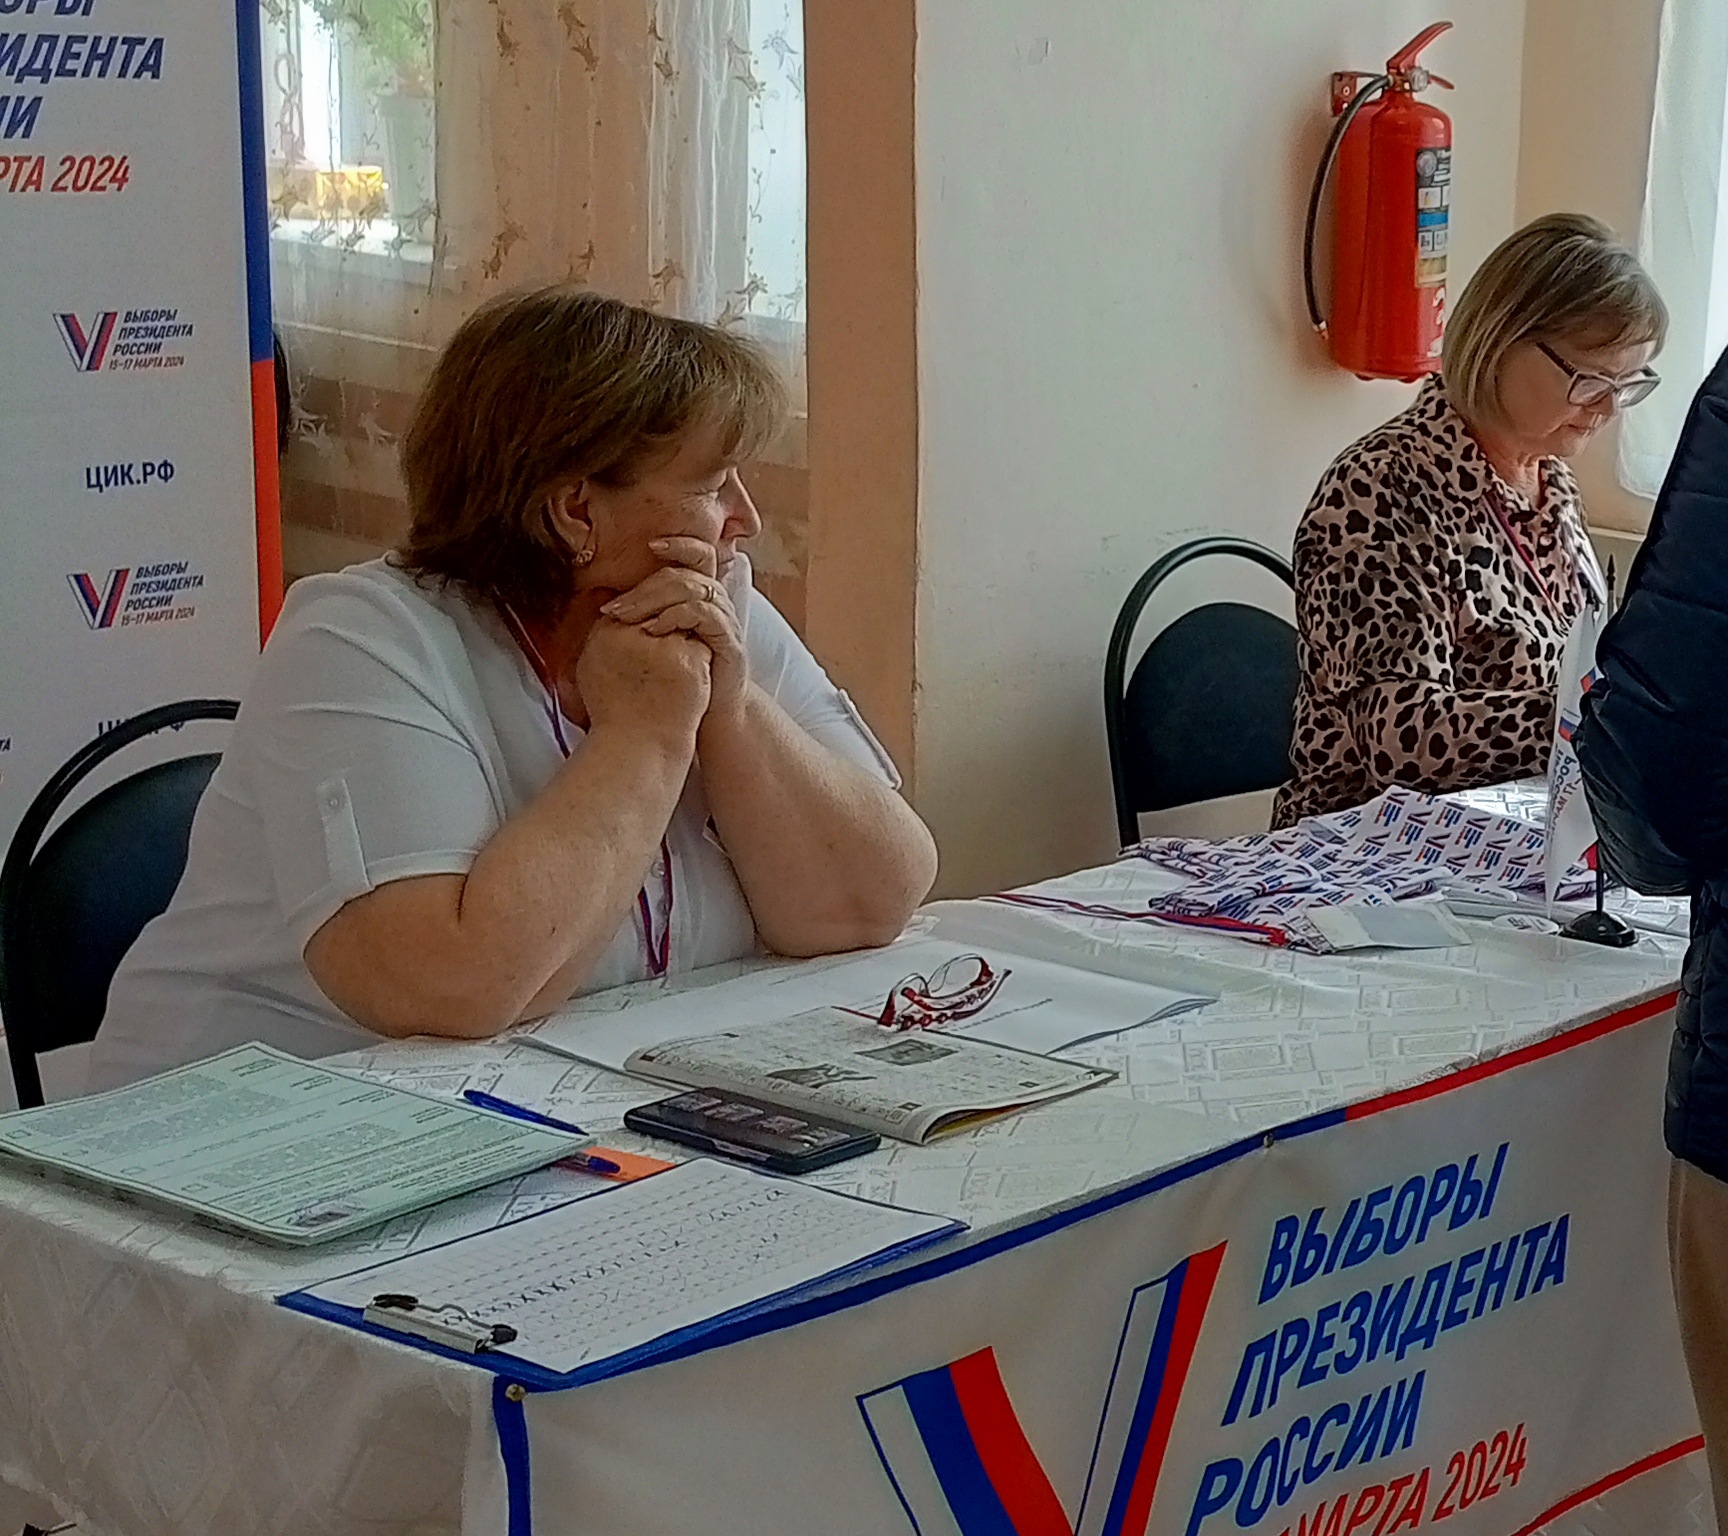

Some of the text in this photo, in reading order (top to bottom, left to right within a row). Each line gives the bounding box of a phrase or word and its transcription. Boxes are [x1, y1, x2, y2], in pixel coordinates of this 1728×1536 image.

[51, 155, 130, 193] 2024
[123, 309, 178, 324] ВЫБОРЫ
[117, 324, 194, 341] ПРЕЗИДЕНТА
[112, 341, 163, 357] РОССИИ
[133, 357, 163, 370] МАРТА
[164, 356, 185, 368] 2024
[85, 459, 175, 493] ЦИК.РФ
[136, 561, 189, 580] ВЫБОРЫ
[130, 574, 204, 596] ПРЕЗИДЕНТА
[124, 594, 174, 612] РОССИИ
[145, 609, 174, 625] МАРТА
[175, 607, 196, 620] 2024
[1257, 1142, 1509, 1306] ВЫБОРЫ
[1220, 1213, 1571, 1427] ПРЕЗИДЕНТА
[1433, 1423, 1526, 1523] 2024
